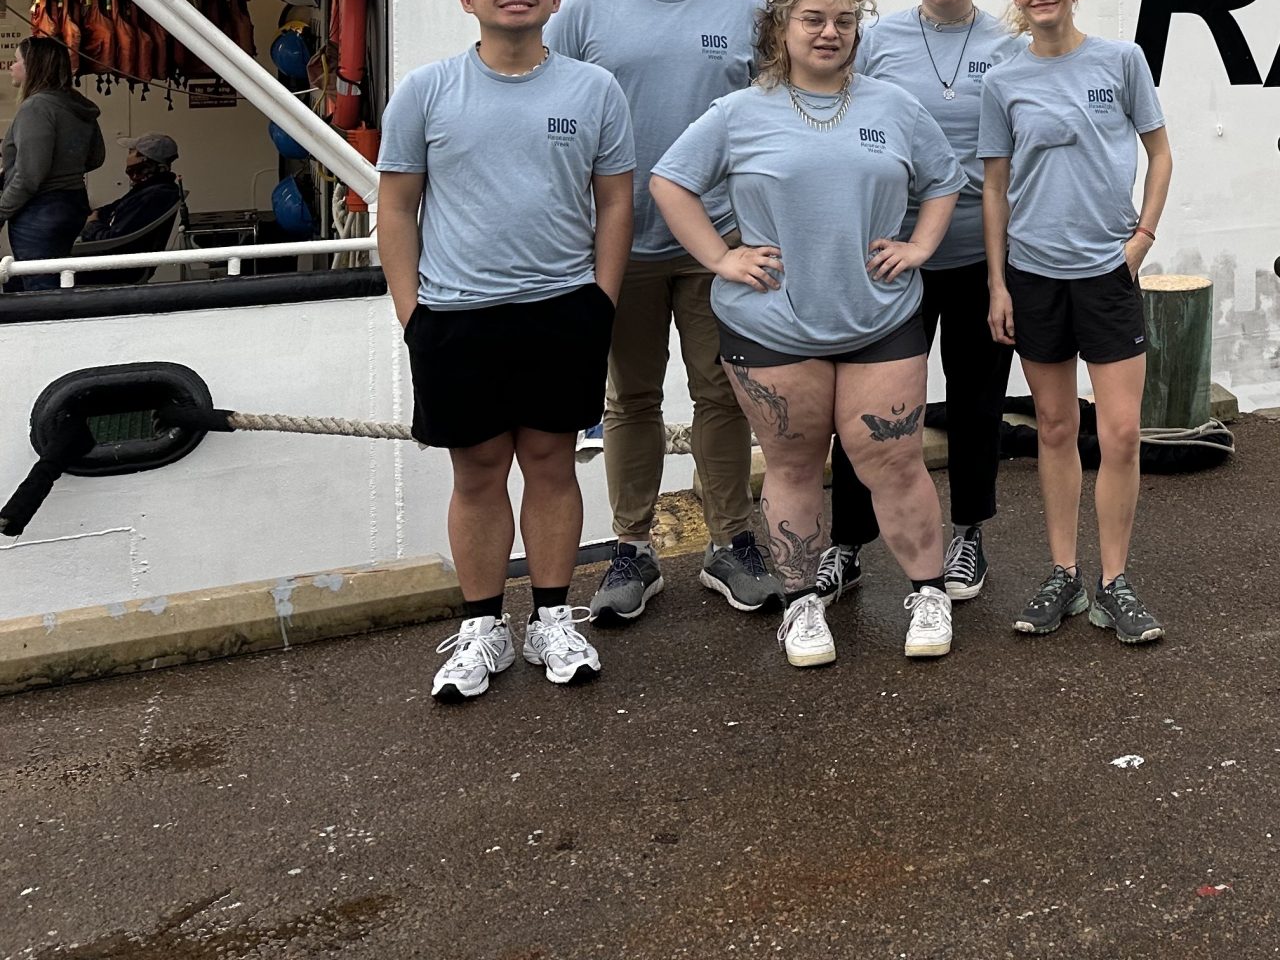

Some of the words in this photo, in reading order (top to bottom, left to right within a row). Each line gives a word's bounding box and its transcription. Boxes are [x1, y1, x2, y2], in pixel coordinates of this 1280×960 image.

[701, 34, 728, 49] BIOS
[1087, 89, 1114, 103] BIOS
[547, 117, 577, 134] BIOS
[859, 127, 886, 144] BIOS
